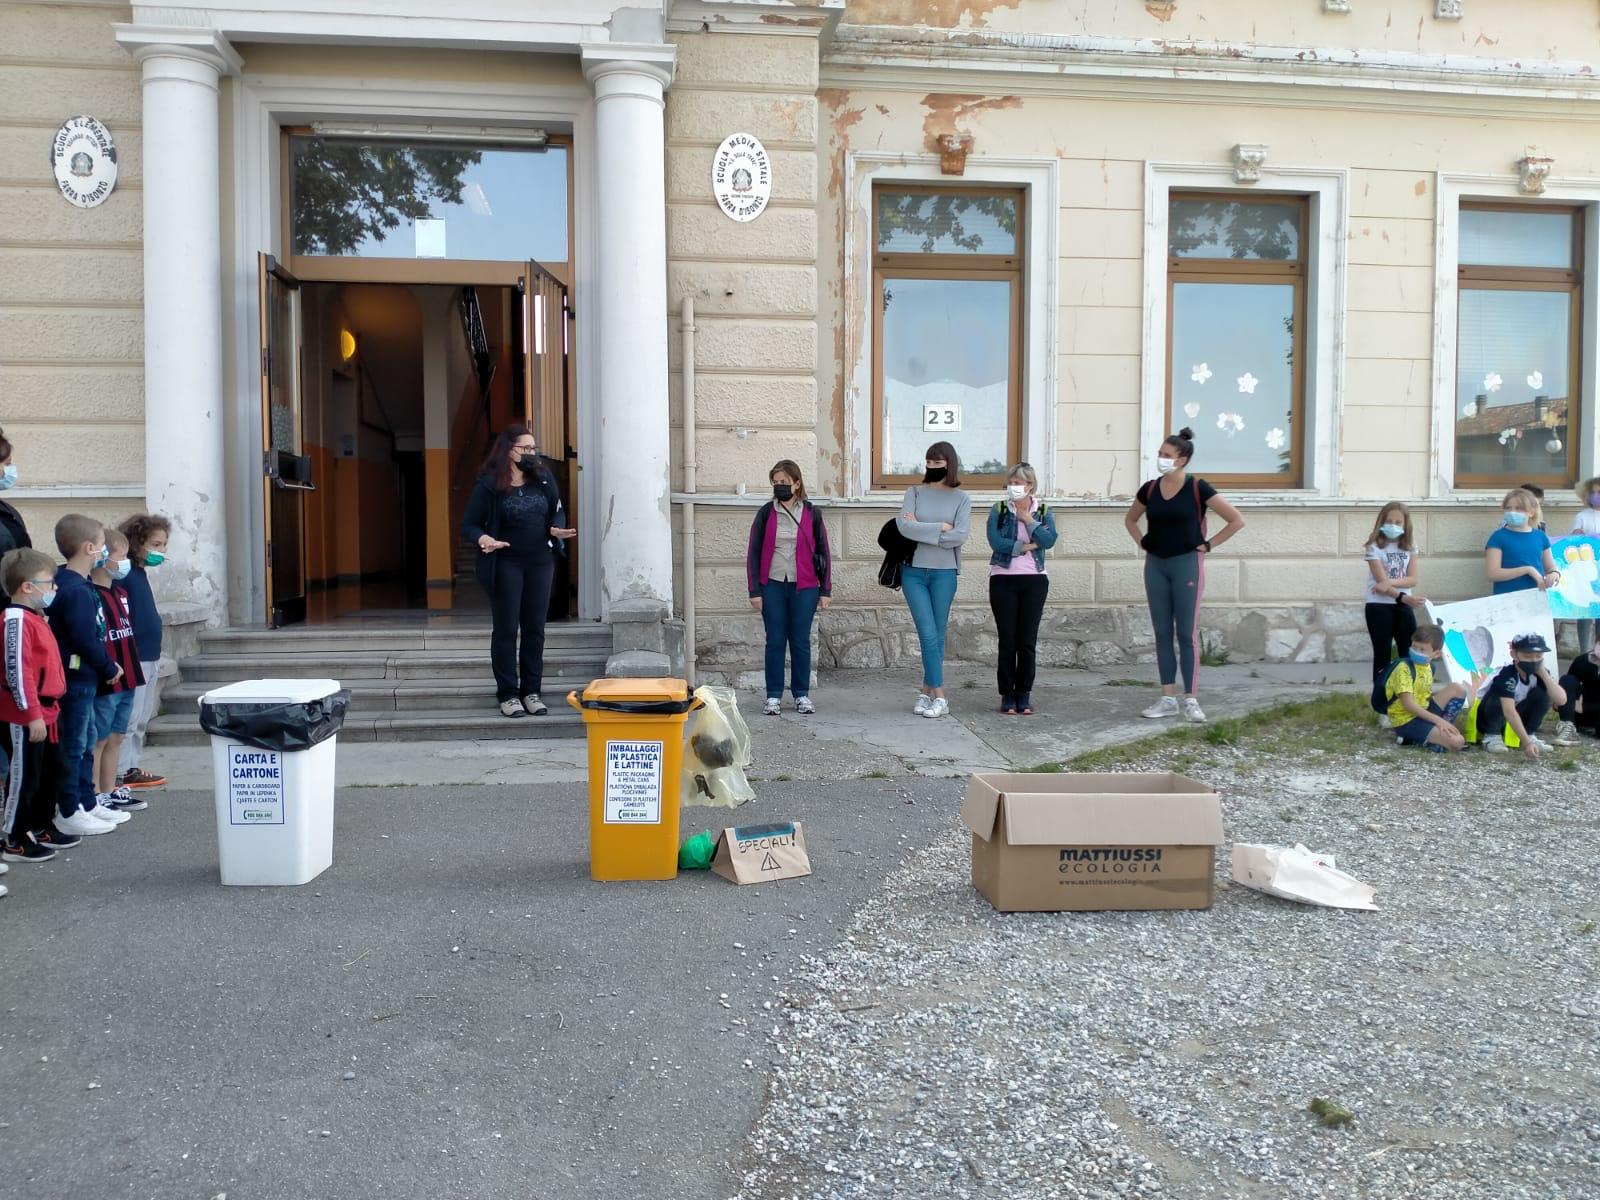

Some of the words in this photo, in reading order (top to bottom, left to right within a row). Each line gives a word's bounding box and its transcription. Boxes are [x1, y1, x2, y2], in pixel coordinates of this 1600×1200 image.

[56, 126, 72, 157] SCUOLA
[74, 120, 109, 157] ELEMENTARE
[717, 151, 730, 183] SCUOLA
[729, 137, 755, 149] MEDIA
[756, 151, 768, 184] STATALE
[61, 180, 78, 200] FARRA
[82, 180, 108, 204] D'ISONZO
[720, 194, 736, 213] FARRA
[739, 196, 764, 215] D'ISONZO
[928, 410, 954, 424] 23
[108, 626, 133, 640] Emira
[610, 745, 658, 753] IMBALLAGGI
[235, 753, 268, 764] CARTA
[270, 754, 276, 764] E
[233, 768, 279, 778] CARTONE
